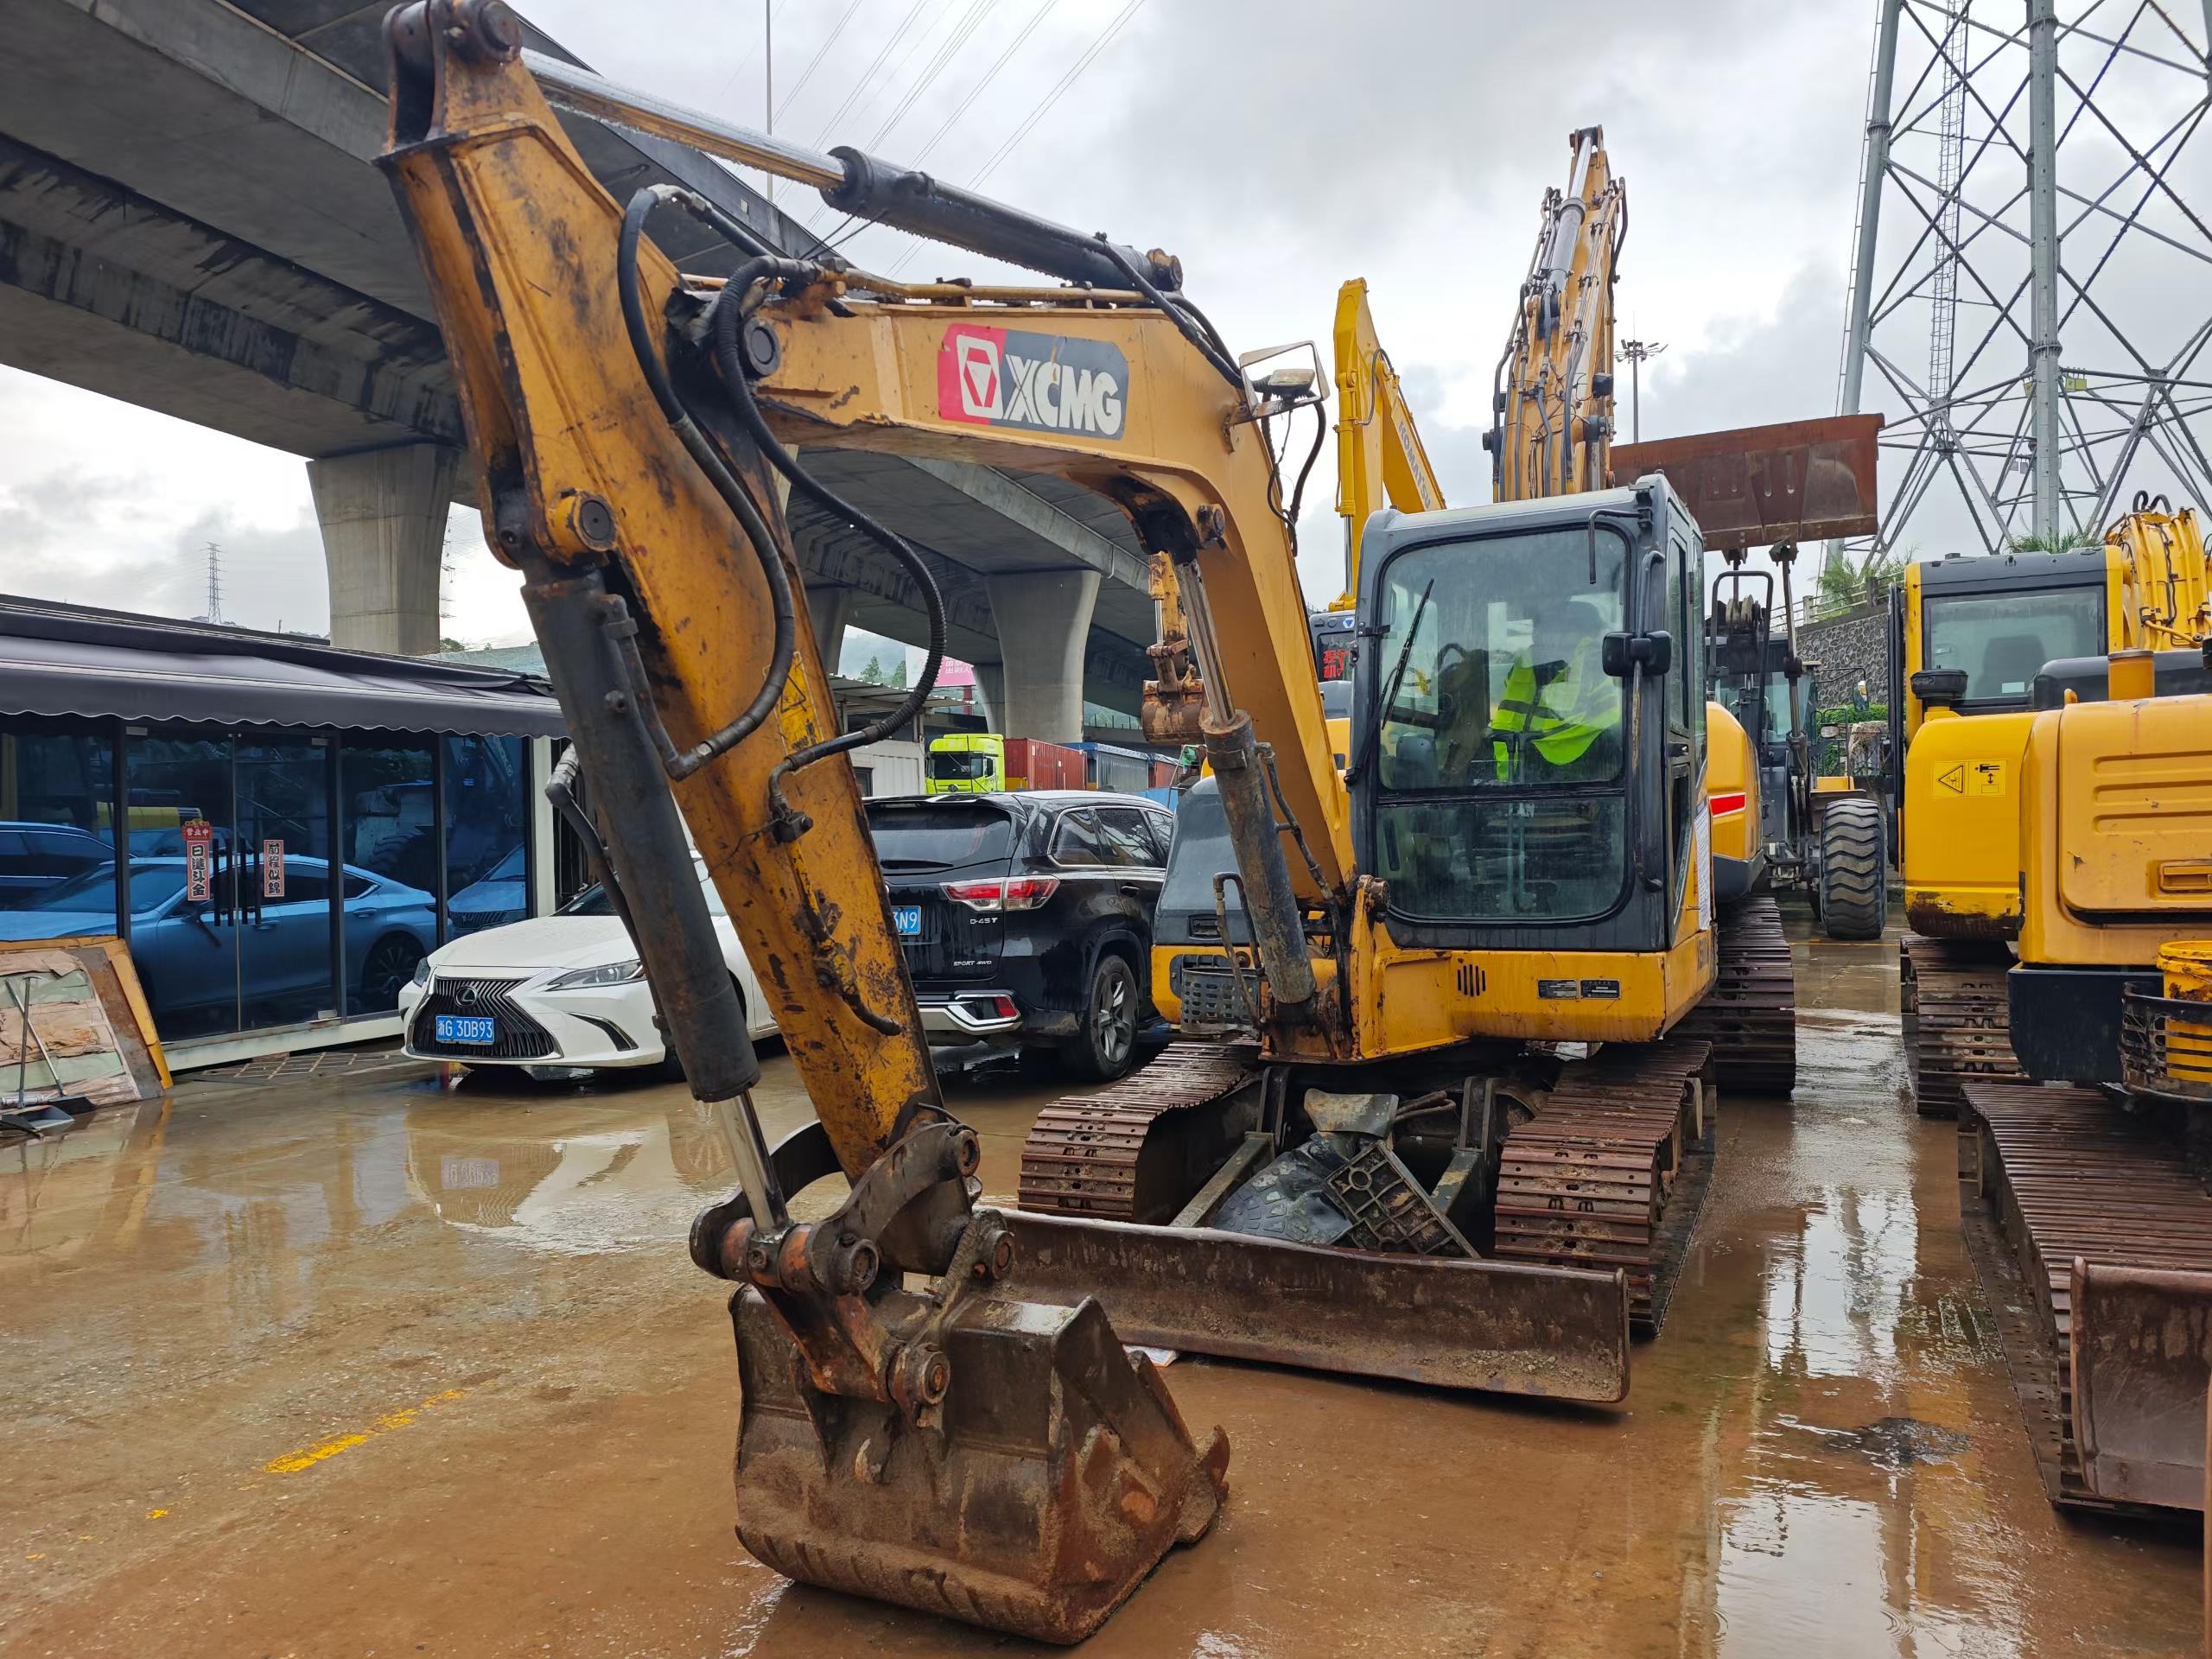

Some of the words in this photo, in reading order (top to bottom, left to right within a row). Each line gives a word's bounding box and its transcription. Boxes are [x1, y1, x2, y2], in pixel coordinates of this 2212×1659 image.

[1003, 354, 1122, 435] XCMG
[1398, 420, 1431, 509] KOMATSU
[186, 828, 209, 836] 营业中
[456, 1020, 493, 1039] 3DB93
